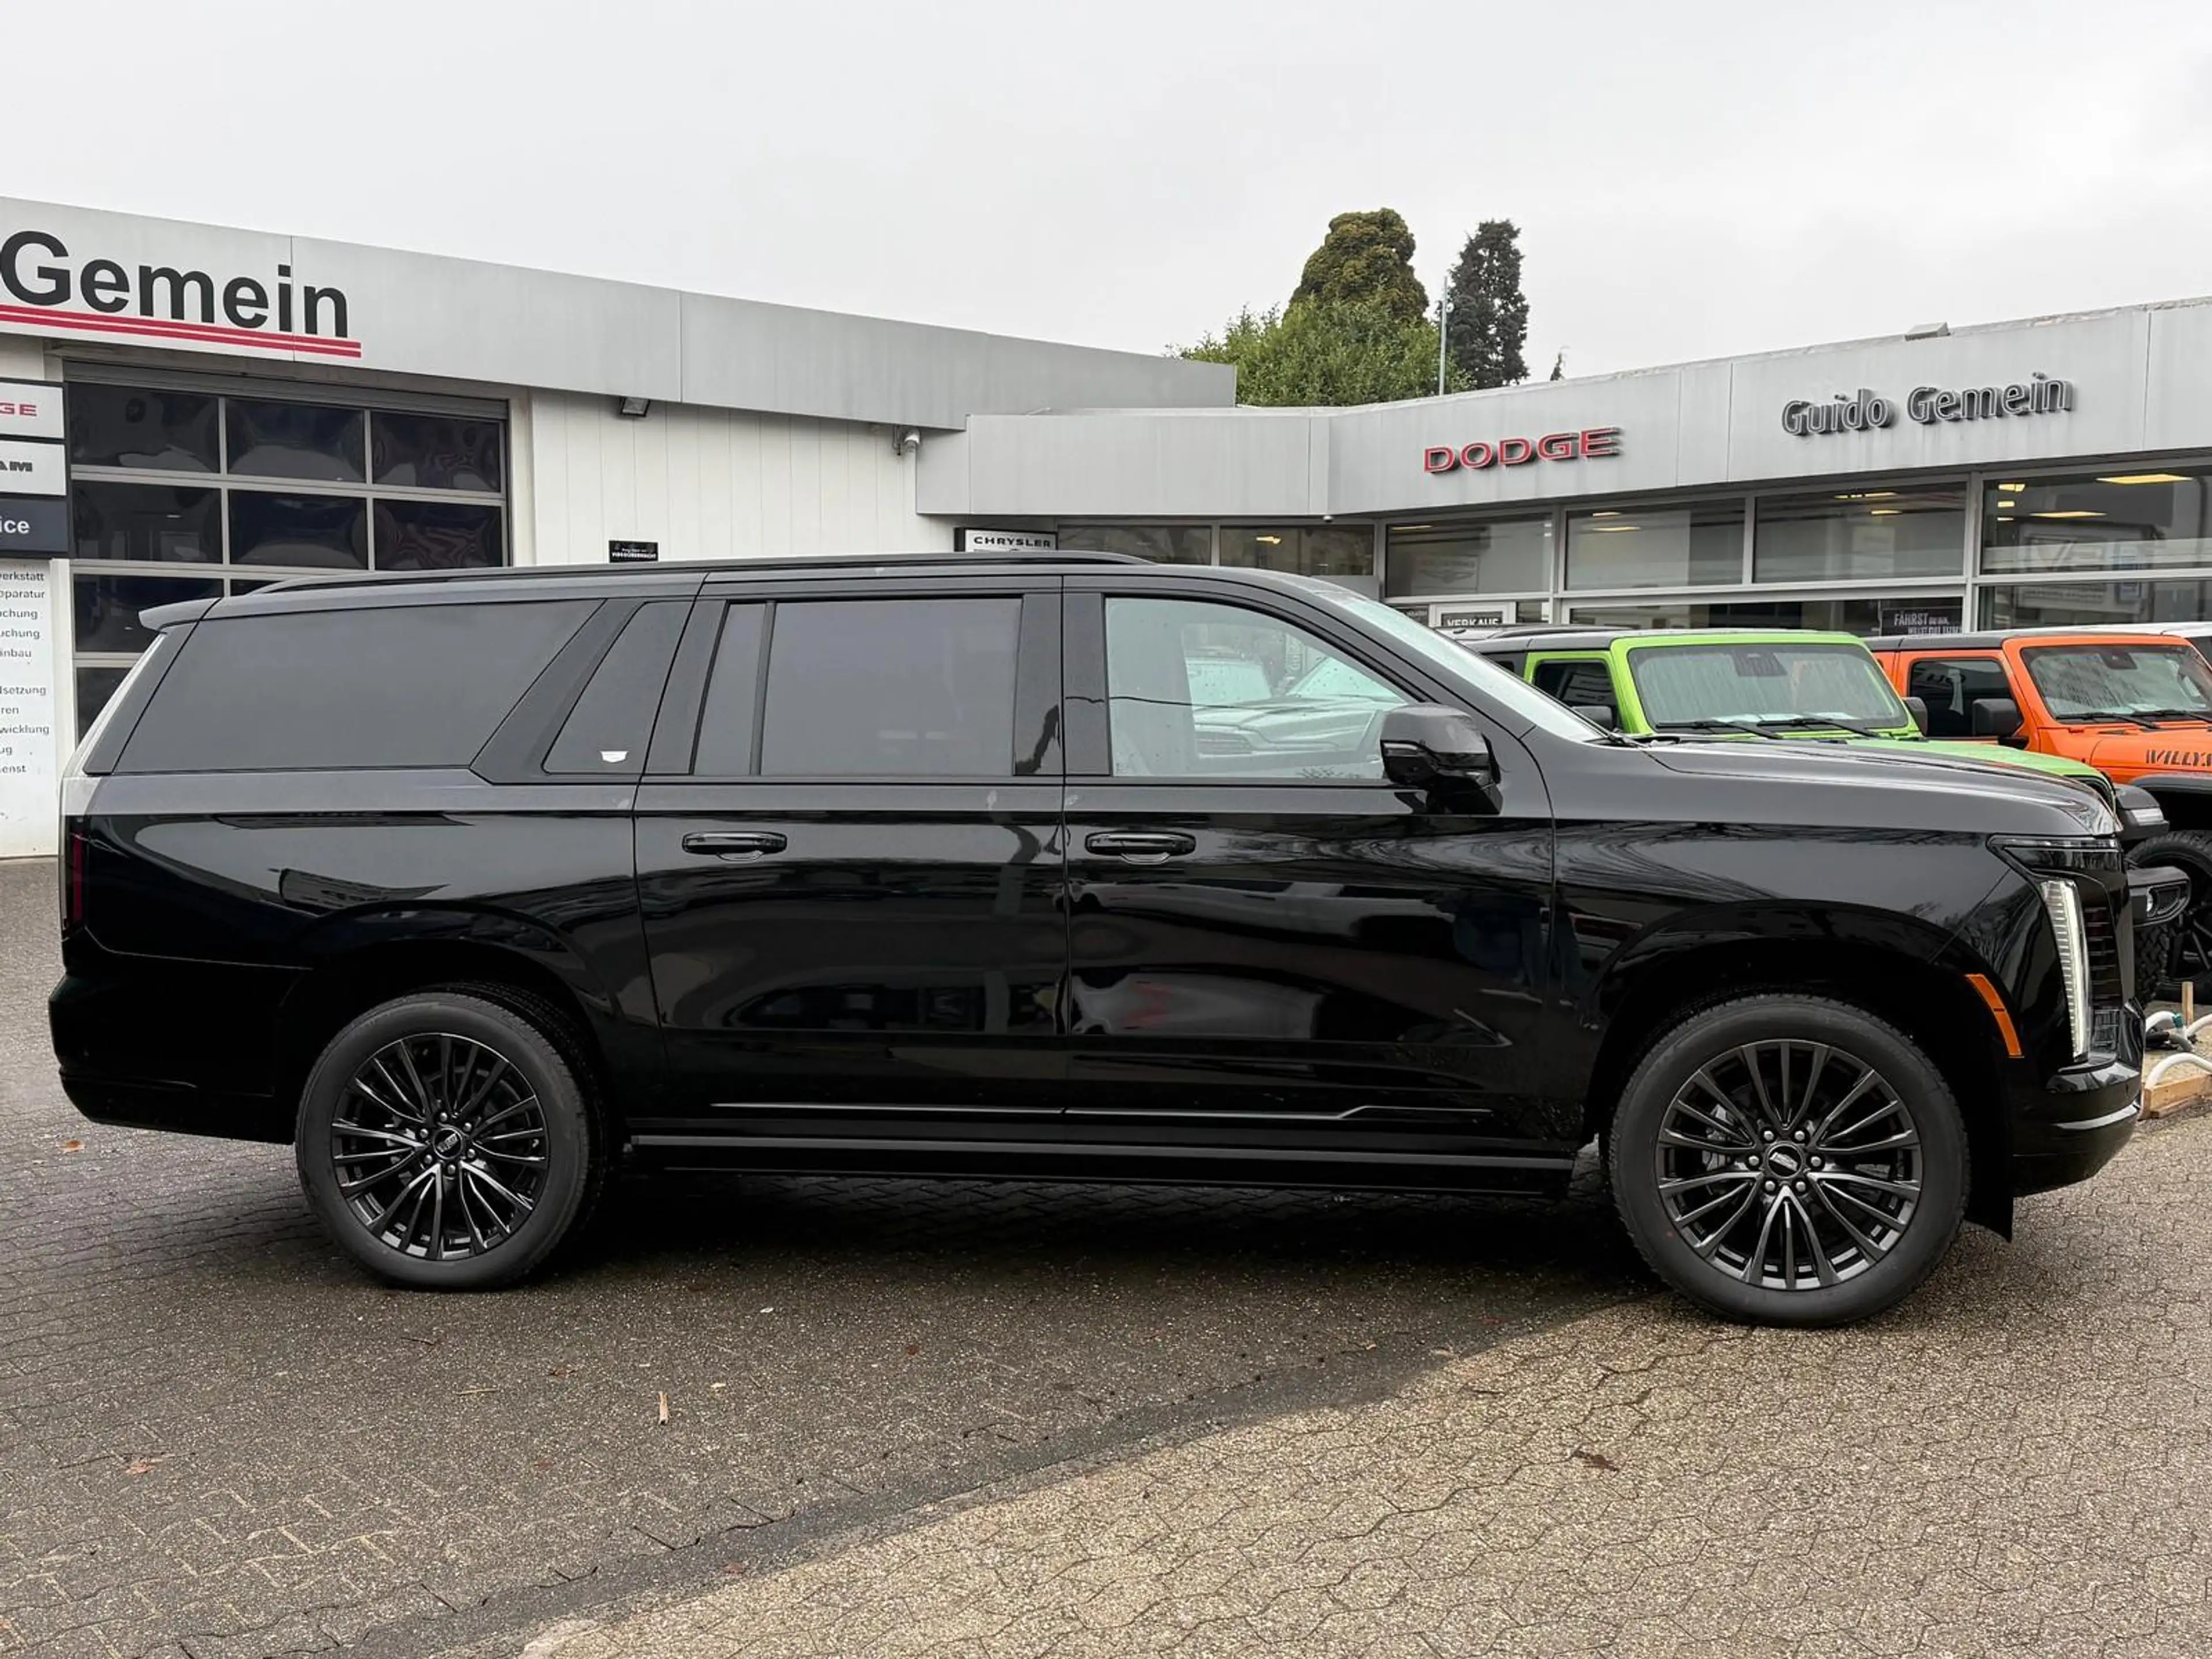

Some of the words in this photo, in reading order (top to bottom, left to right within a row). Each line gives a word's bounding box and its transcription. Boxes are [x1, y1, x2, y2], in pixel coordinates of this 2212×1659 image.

[0, 230, 348, 338] Gemein
[1782, 388, 1894, 435] Guido
[1907, 372, 2074, 424] Gemein
[1424, 427, 1623, 475] DODGE
[974, 536, 1051, 547] CHRYSLER
[0, 571, 44, 581] erkstatt
[0, 609, 38, 620] chung
